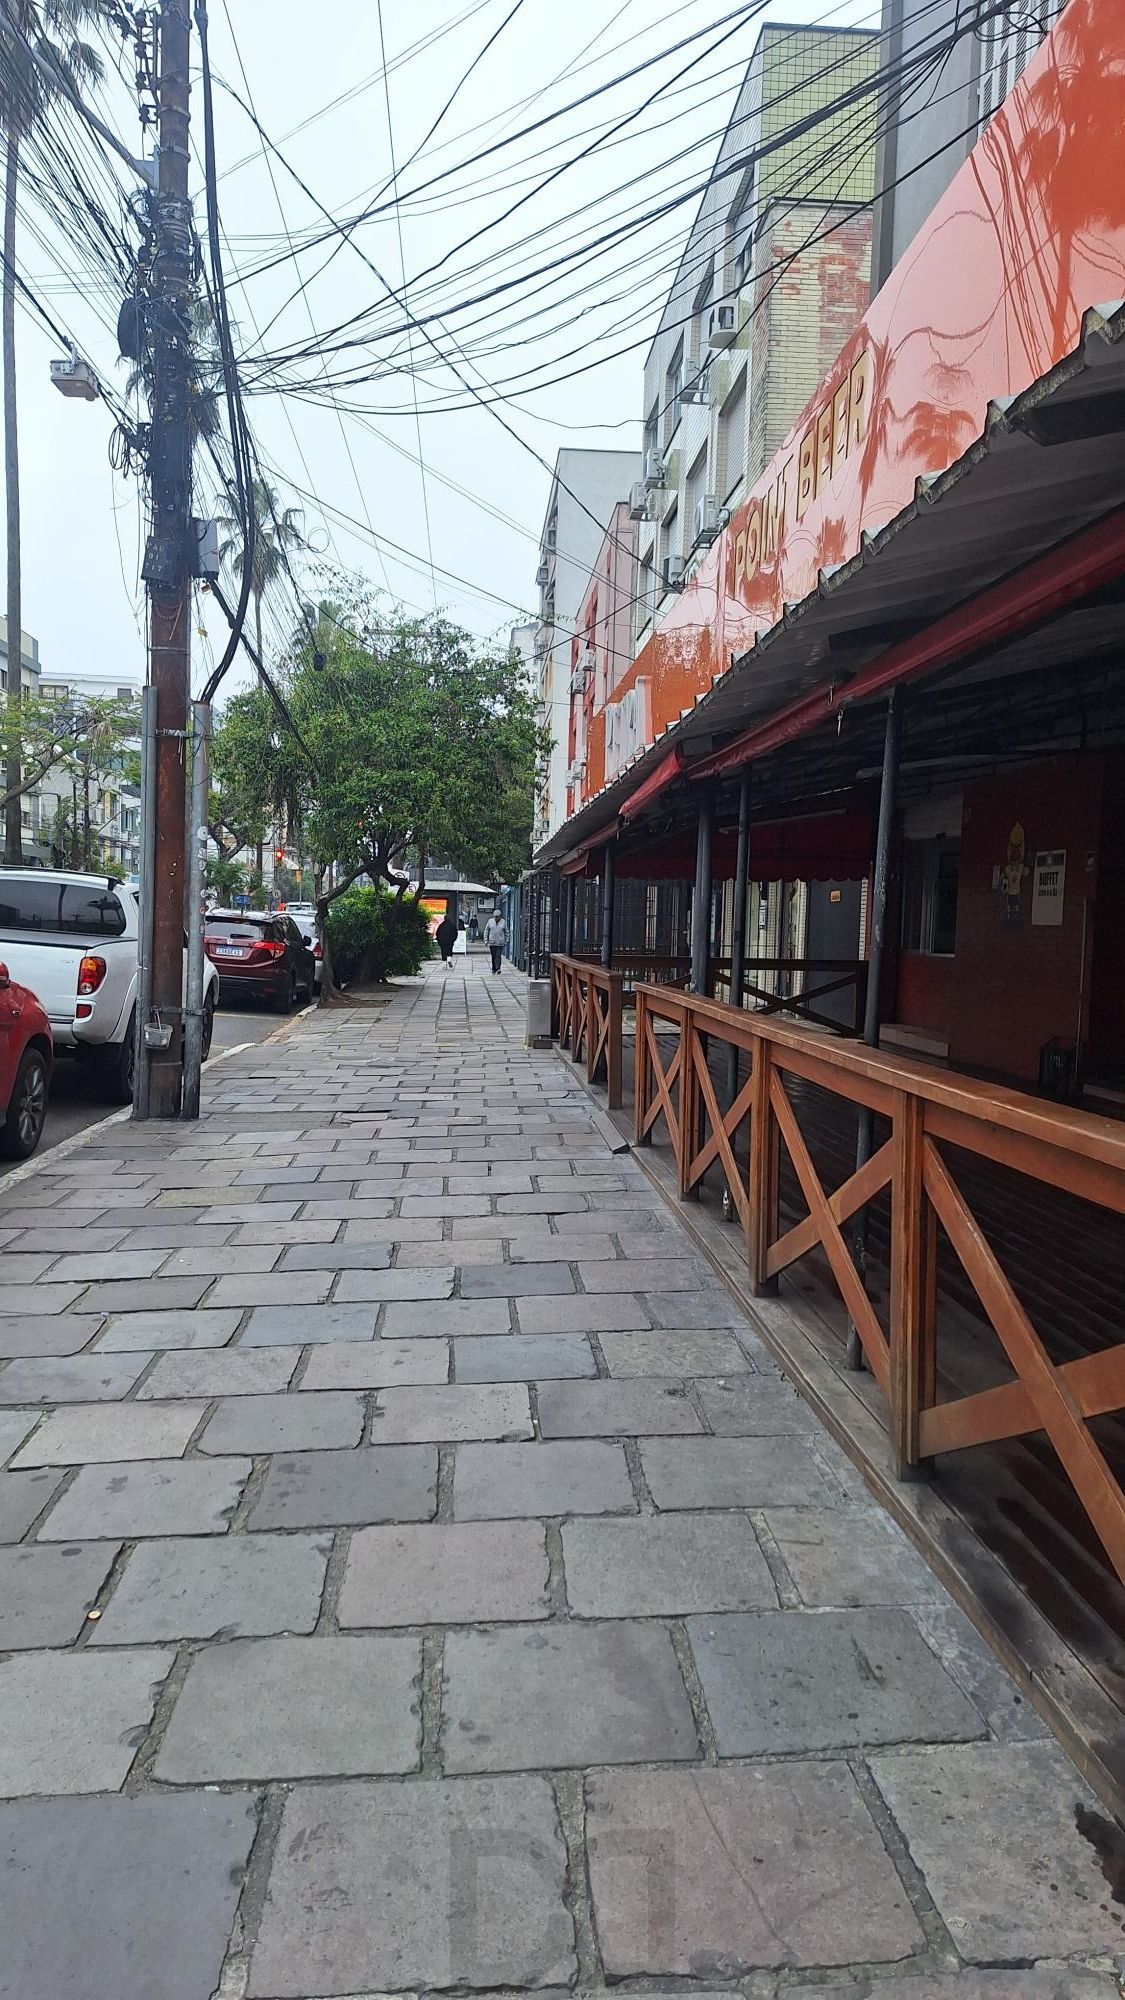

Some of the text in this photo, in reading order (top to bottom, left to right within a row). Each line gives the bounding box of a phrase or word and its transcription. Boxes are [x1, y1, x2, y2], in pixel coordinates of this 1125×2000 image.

[734, 350, 874, 600] POINT BEER
[1039, 871, 1059, 886] BUFFET
